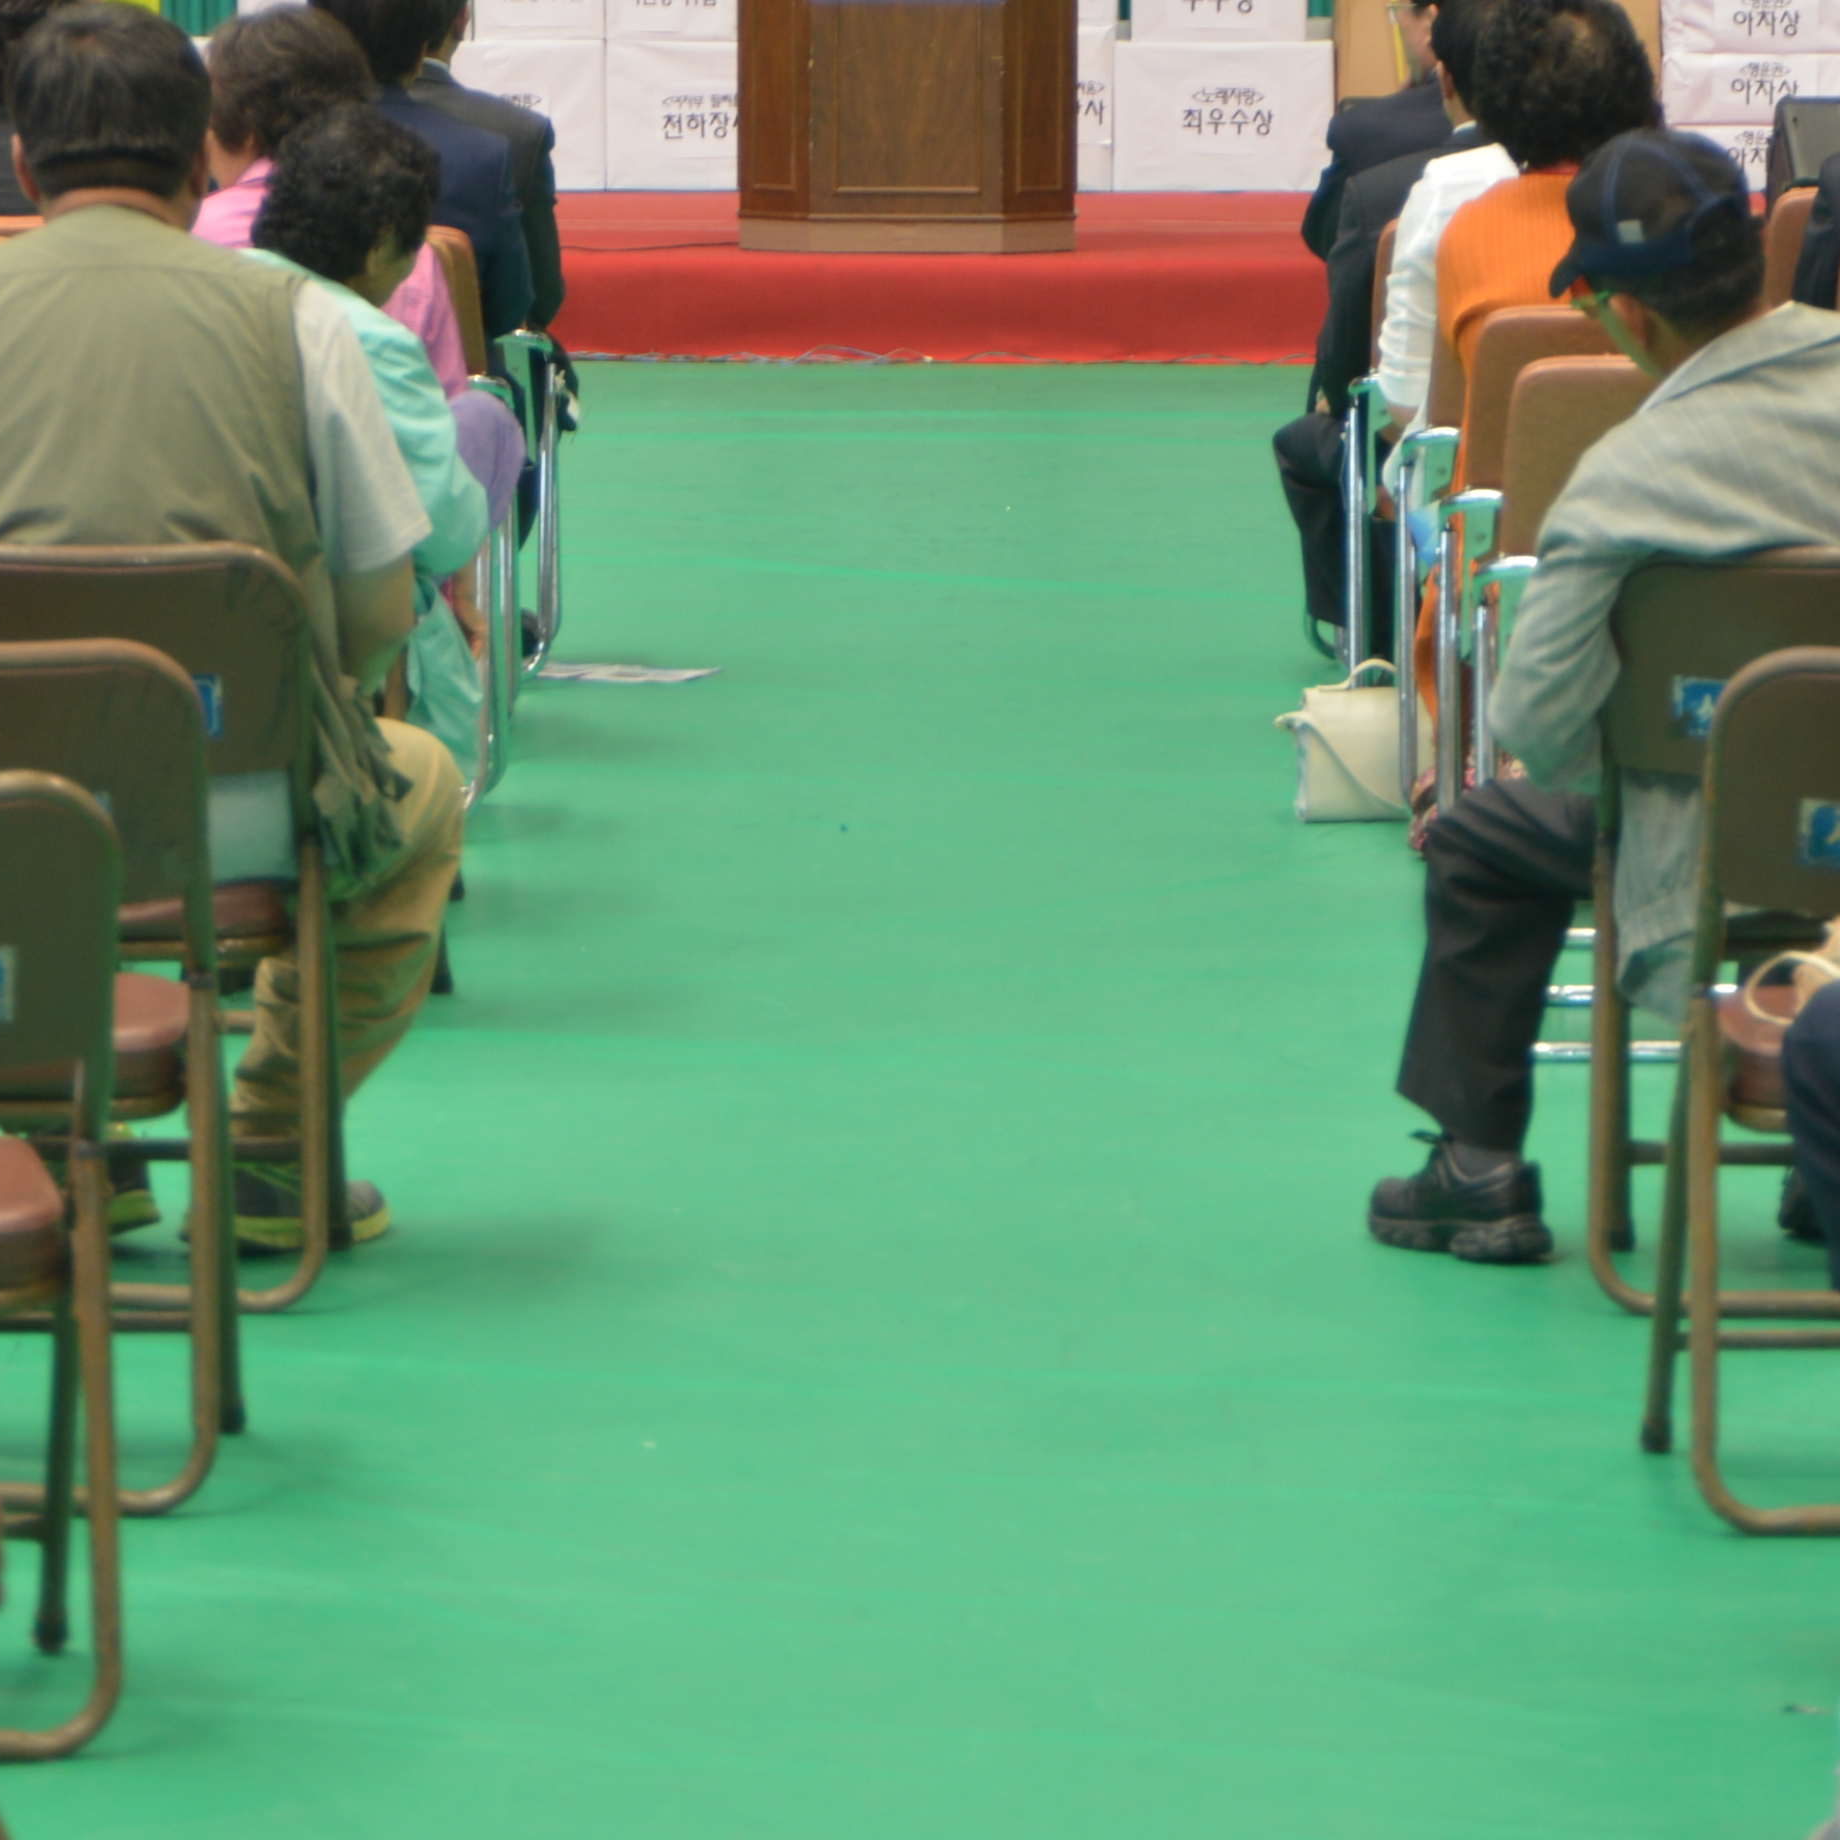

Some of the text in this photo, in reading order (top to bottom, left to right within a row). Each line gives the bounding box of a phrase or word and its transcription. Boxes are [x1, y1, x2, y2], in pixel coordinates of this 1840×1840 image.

[1733, 10, 1800, 37] 아자상
[663, 112, 738, 140] 천하장
[1182, 108, 1274, 136] 최우수상
